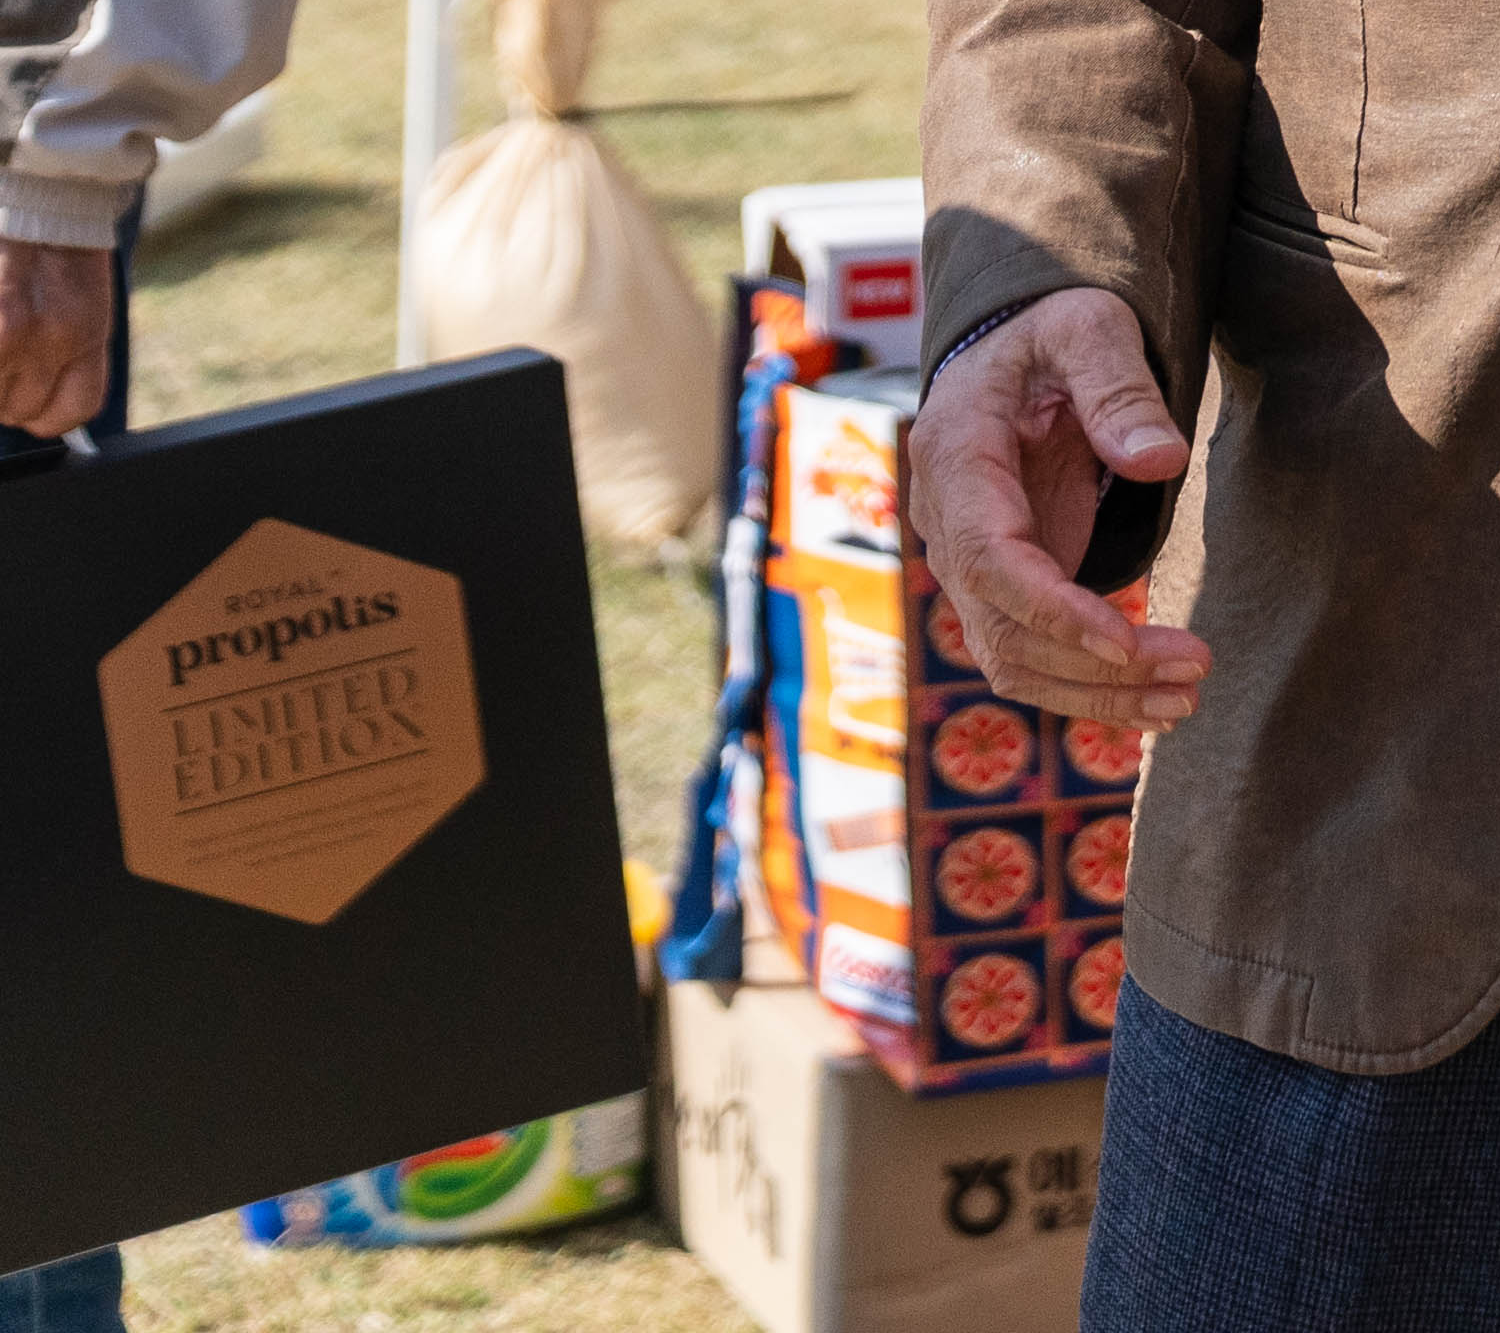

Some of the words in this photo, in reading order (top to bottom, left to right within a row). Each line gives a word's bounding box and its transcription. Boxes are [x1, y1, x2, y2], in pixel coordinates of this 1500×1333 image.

[165, 590, 399, 687] propolis
[225, 581, 321, 614] ROYAL
[172, 661, 421, 760] LIMITED
[173, 706, 427, 802] EDITION
